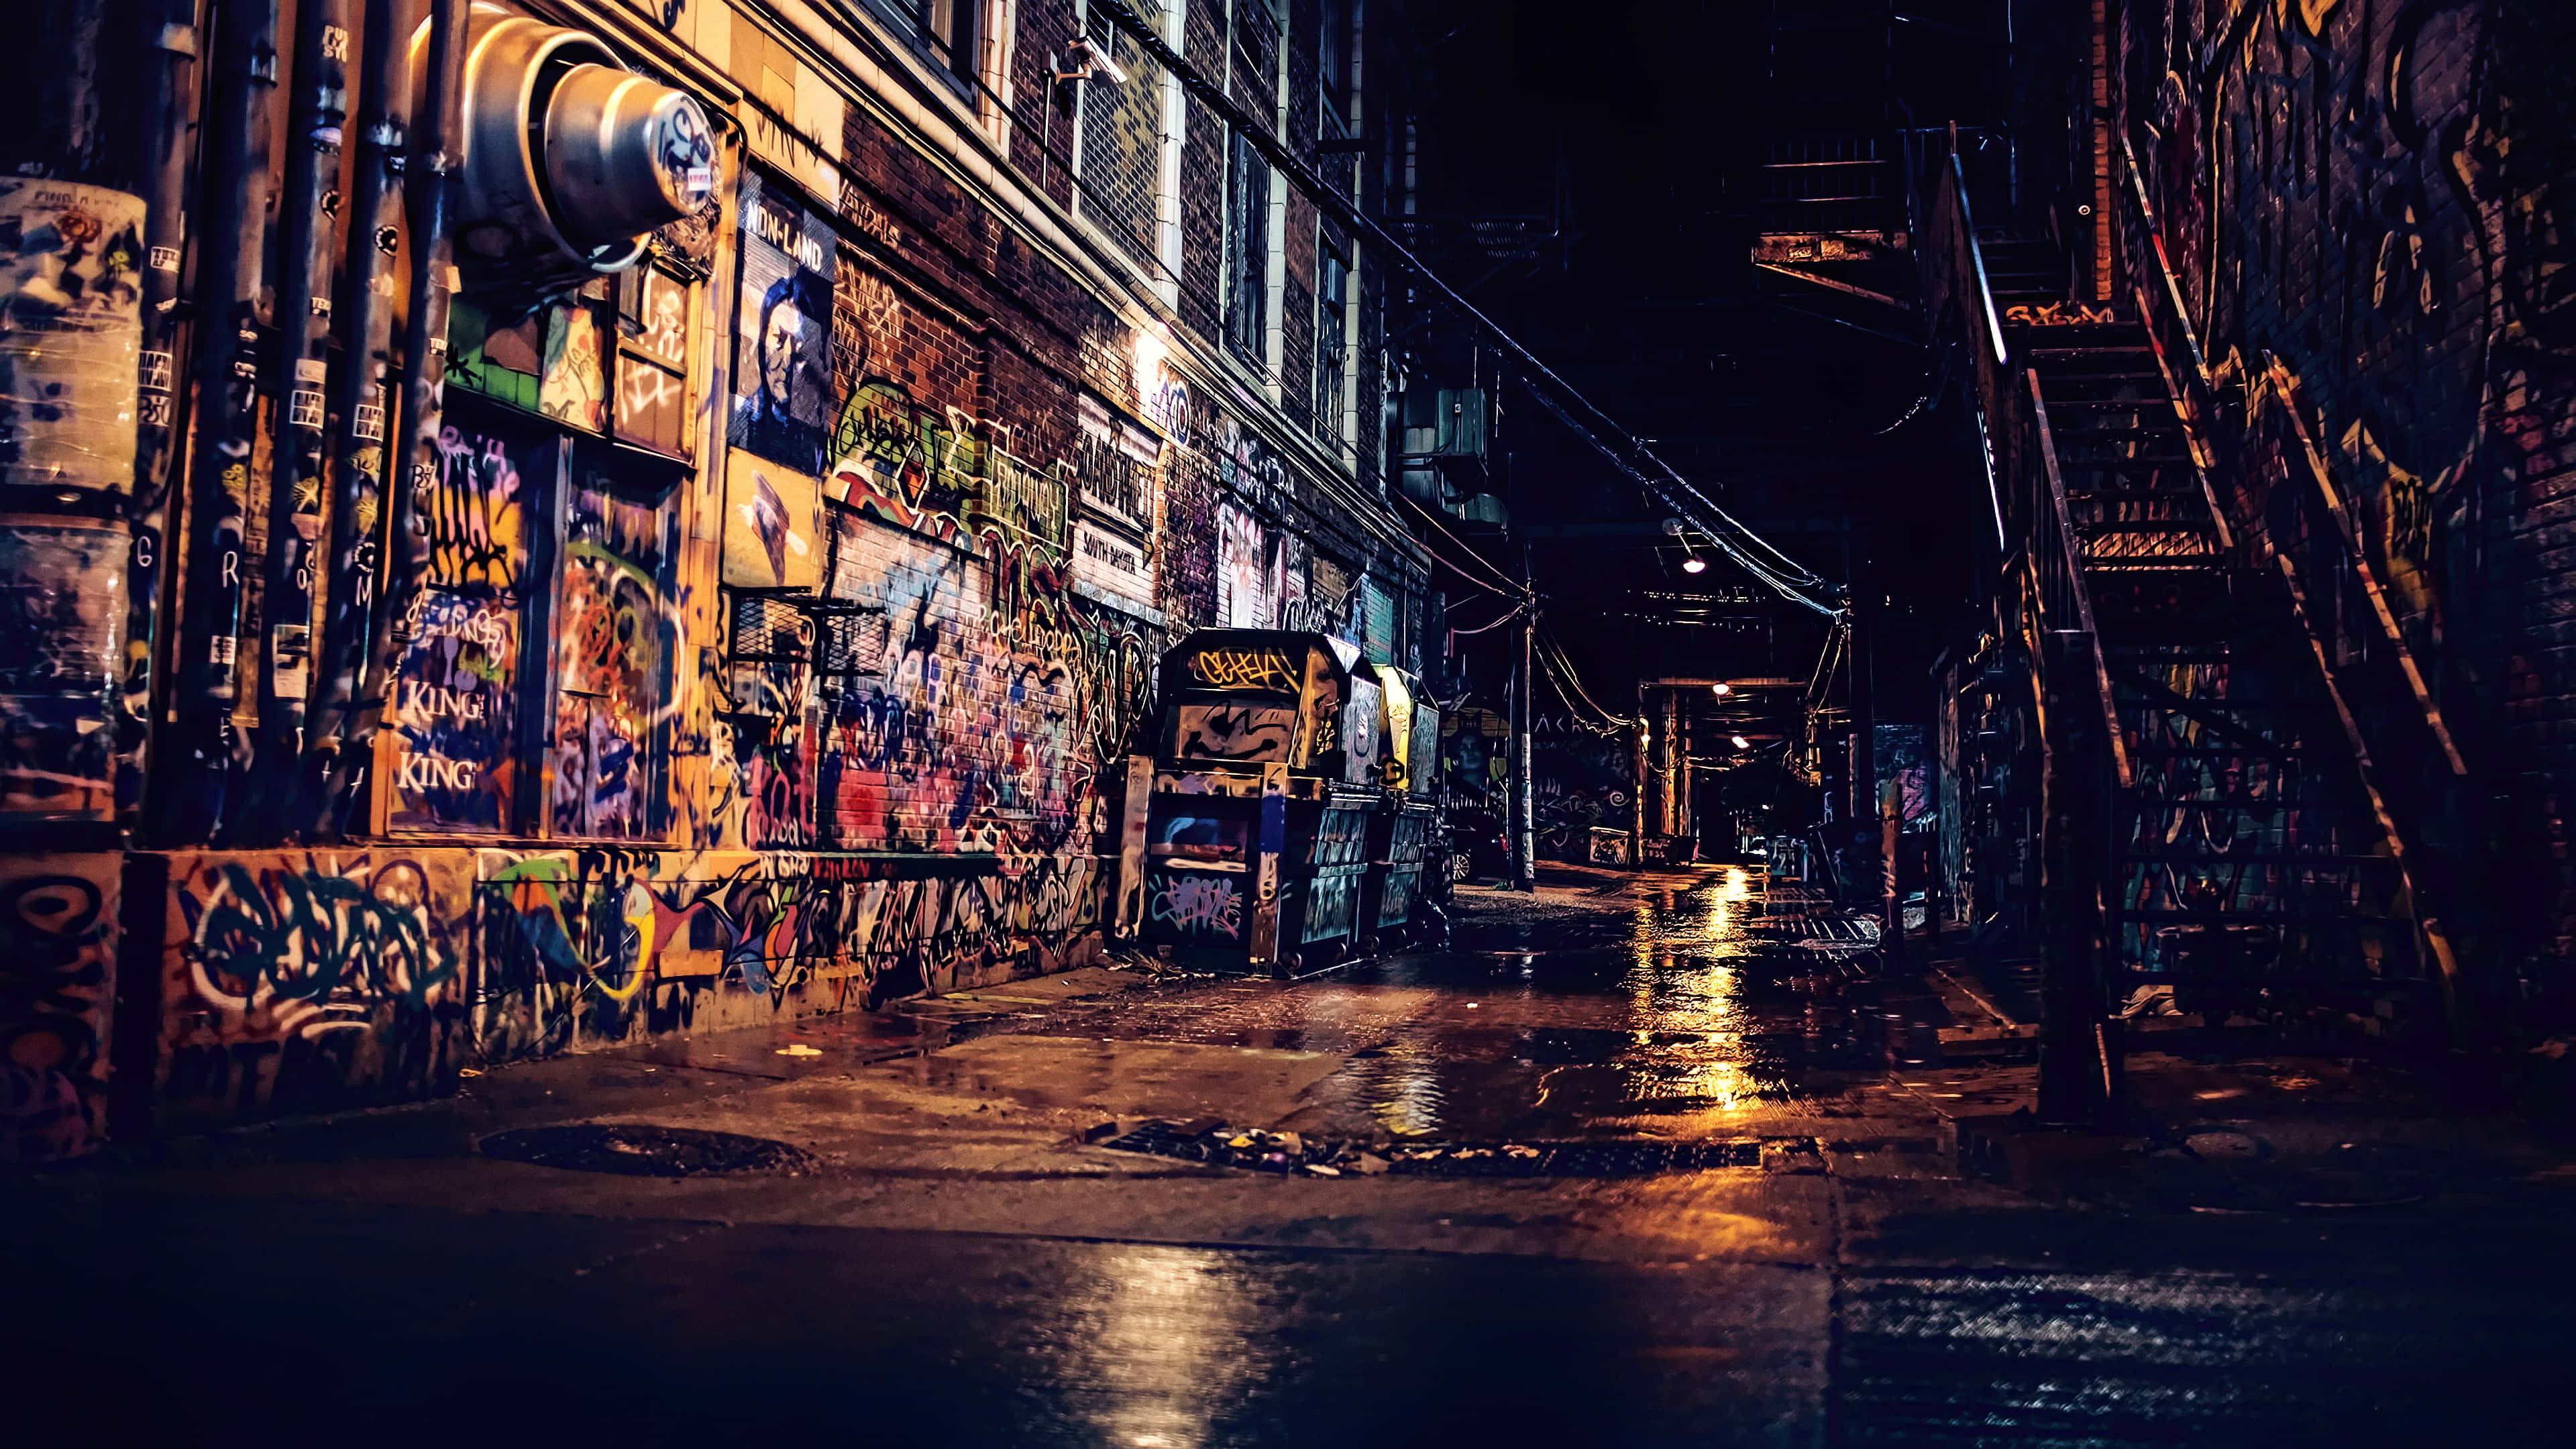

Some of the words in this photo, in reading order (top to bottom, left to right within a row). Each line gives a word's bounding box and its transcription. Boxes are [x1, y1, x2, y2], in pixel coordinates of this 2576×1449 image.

[222, 551, 239, 588] R
[407, 680, 480, 722] KING
[397, 751, 473, 794] KING
